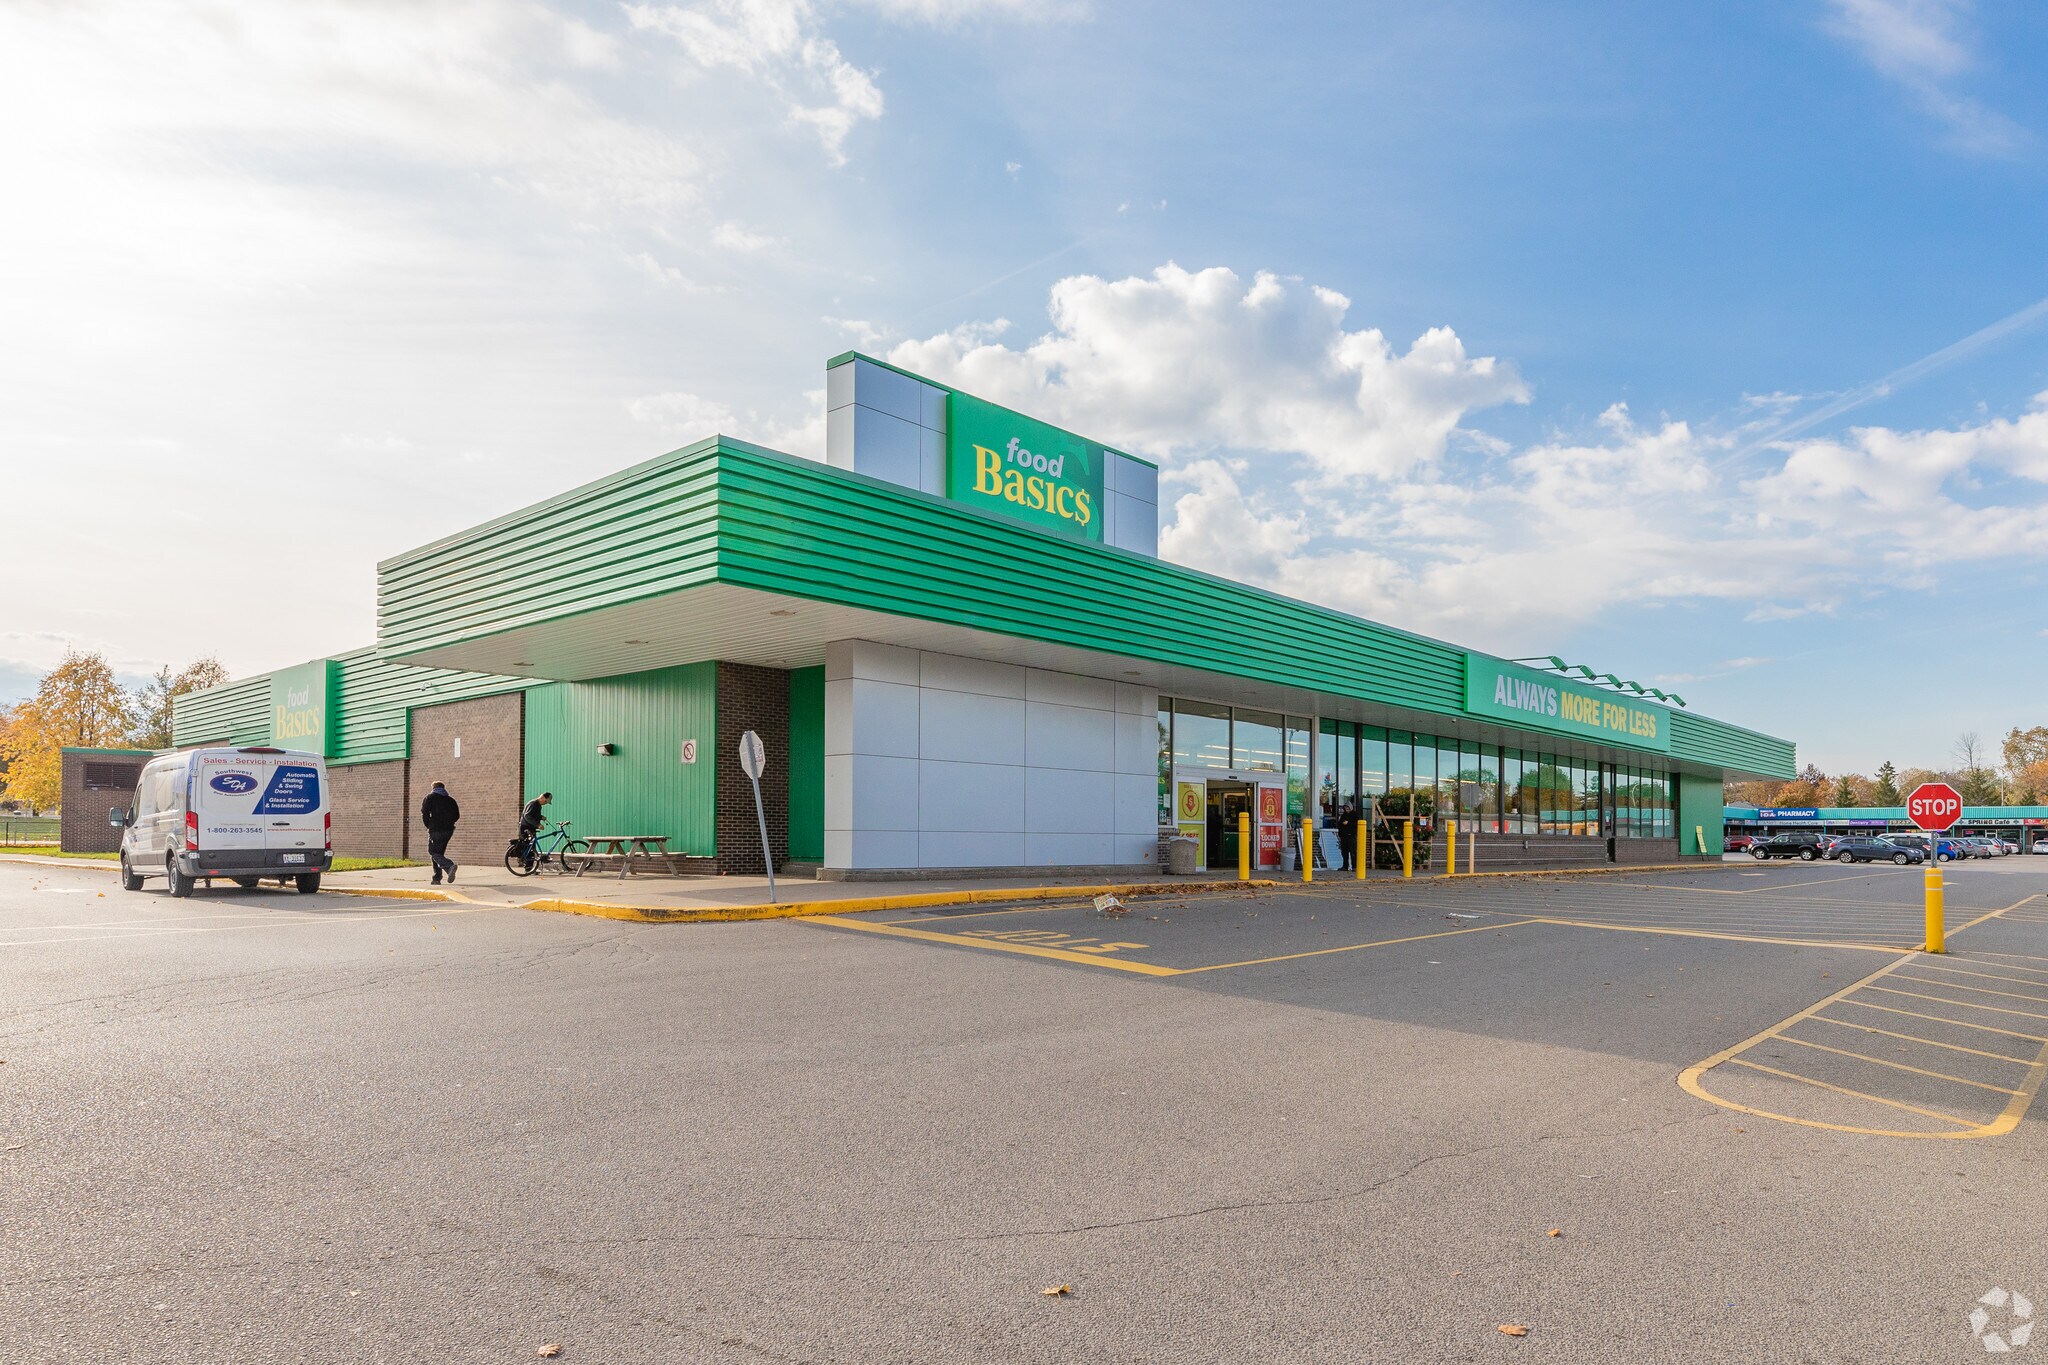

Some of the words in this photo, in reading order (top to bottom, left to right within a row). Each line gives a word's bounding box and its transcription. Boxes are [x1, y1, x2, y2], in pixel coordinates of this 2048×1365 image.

[1006, 437, 1064, 478] food
[287, 684, 309, 708] food
[1494, 674, 1558, 717] ALWAYS
[1561, 691, 1601, 727] MORE
[1603, 703, 1627, 733] FOR
[1629, 709, 1657, 739] LESS
[274, 759, 318, 767] Installation
[222, 776, 247, 791] SDA
[1912, 798, 1958, 816] STOP
[1261, 841, 1277, 849] DOWN
